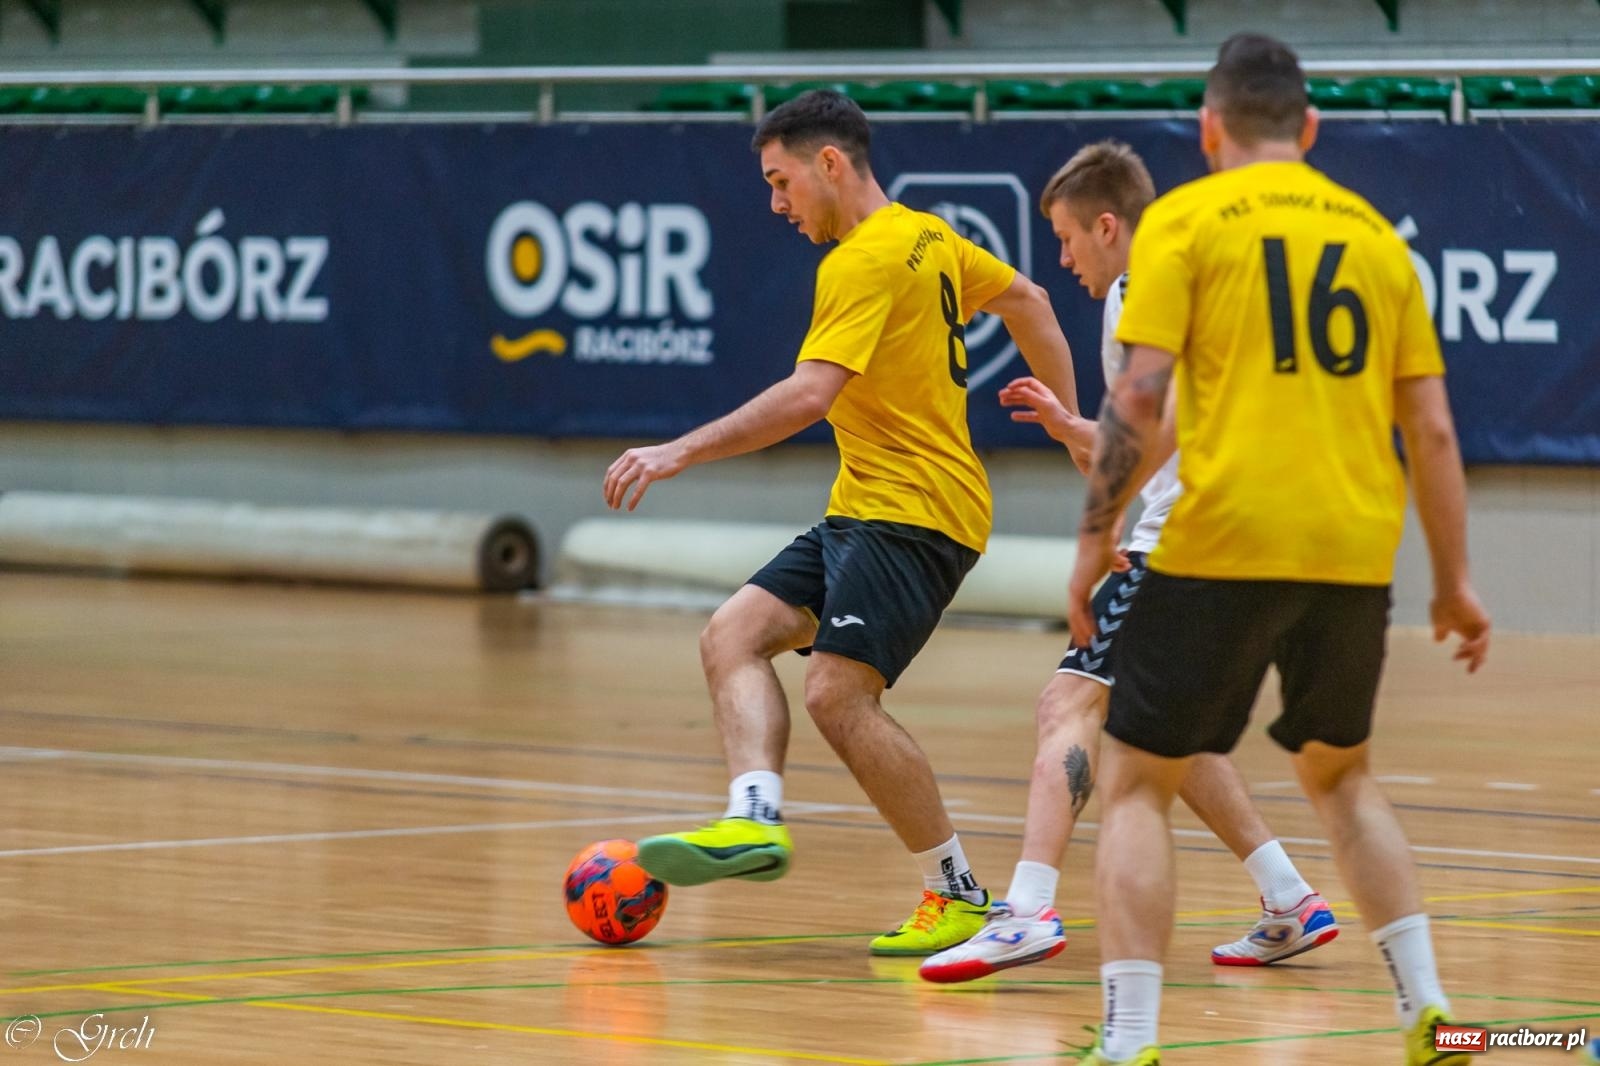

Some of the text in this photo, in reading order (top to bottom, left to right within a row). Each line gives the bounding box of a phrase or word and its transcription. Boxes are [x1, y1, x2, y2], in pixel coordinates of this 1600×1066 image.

[0, 207, 329, 321] RACIBÓRZ
[1262, 236, 1369, 378] 16
[575, 320, 713, 364] RACIBÓRZ
[939, 271, 968, 388] 8
